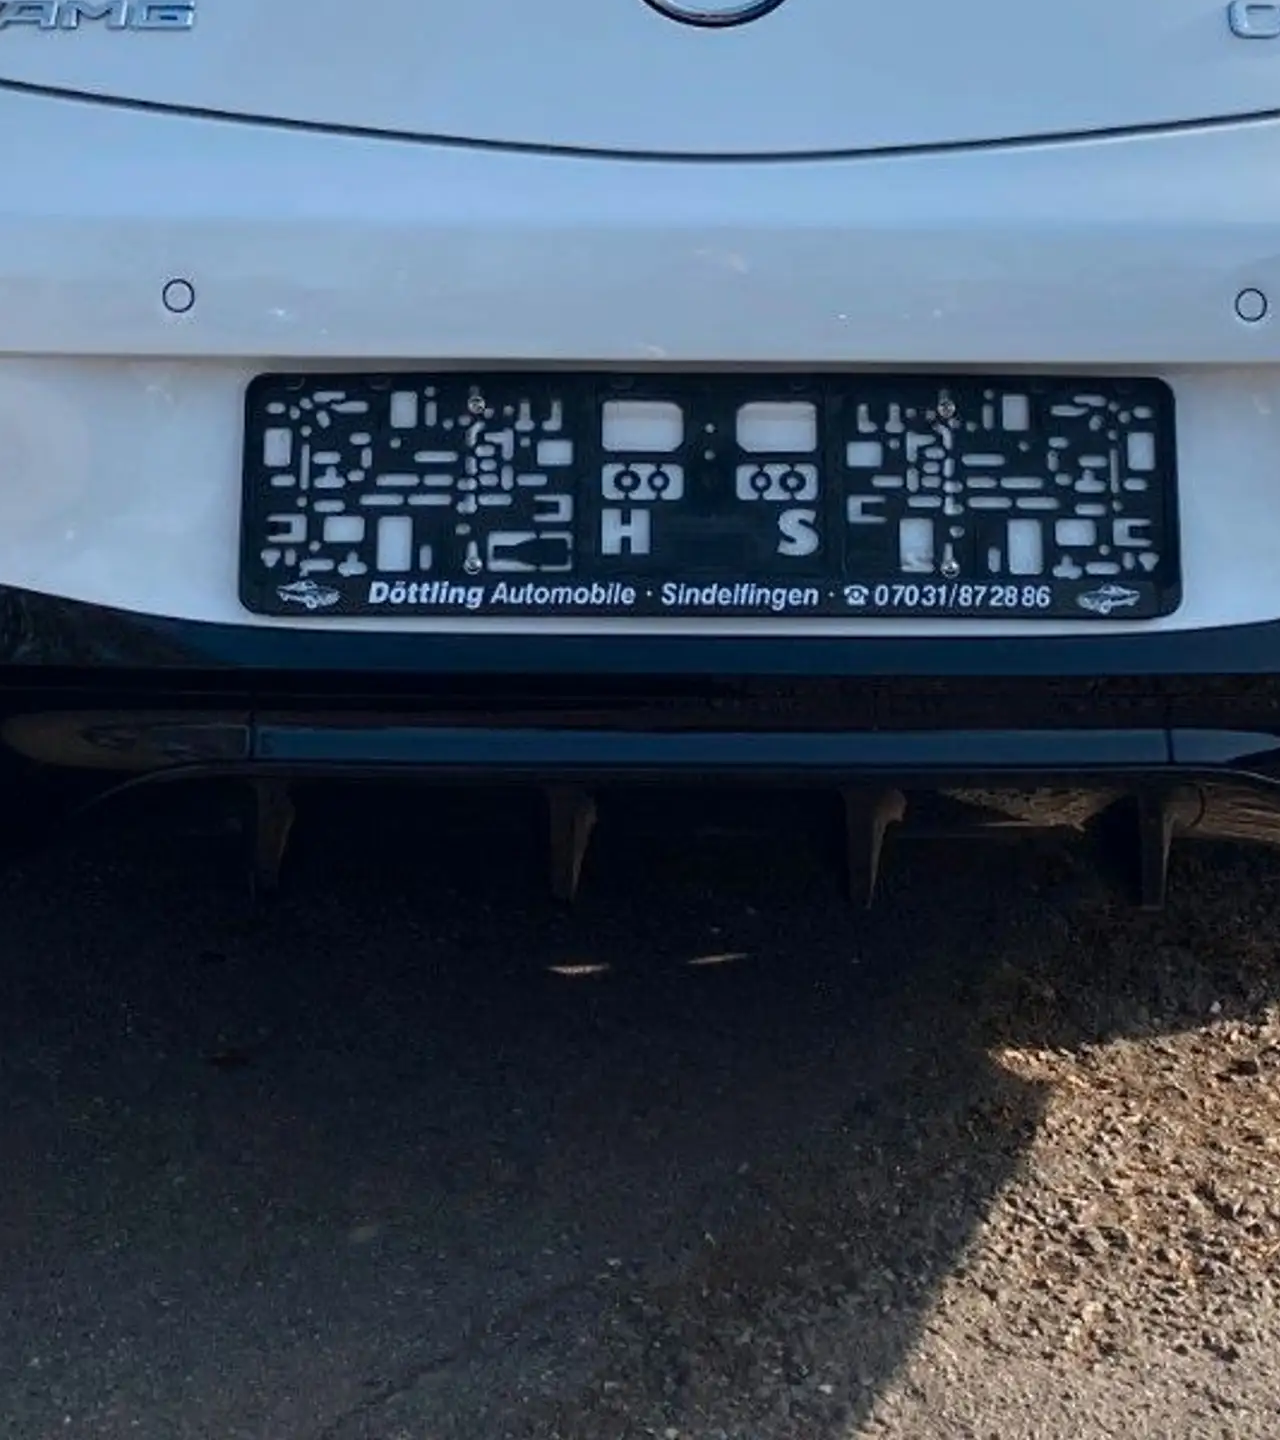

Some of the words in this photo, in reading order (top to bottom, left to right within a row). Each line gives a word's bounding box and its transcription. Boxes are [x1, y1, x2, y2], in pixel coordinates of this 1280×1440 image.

[368, 580, 486, 609] Döttling
[490, 582, 637, 607] Automobile
[660, 582, 820, 608] Sindelfingen
